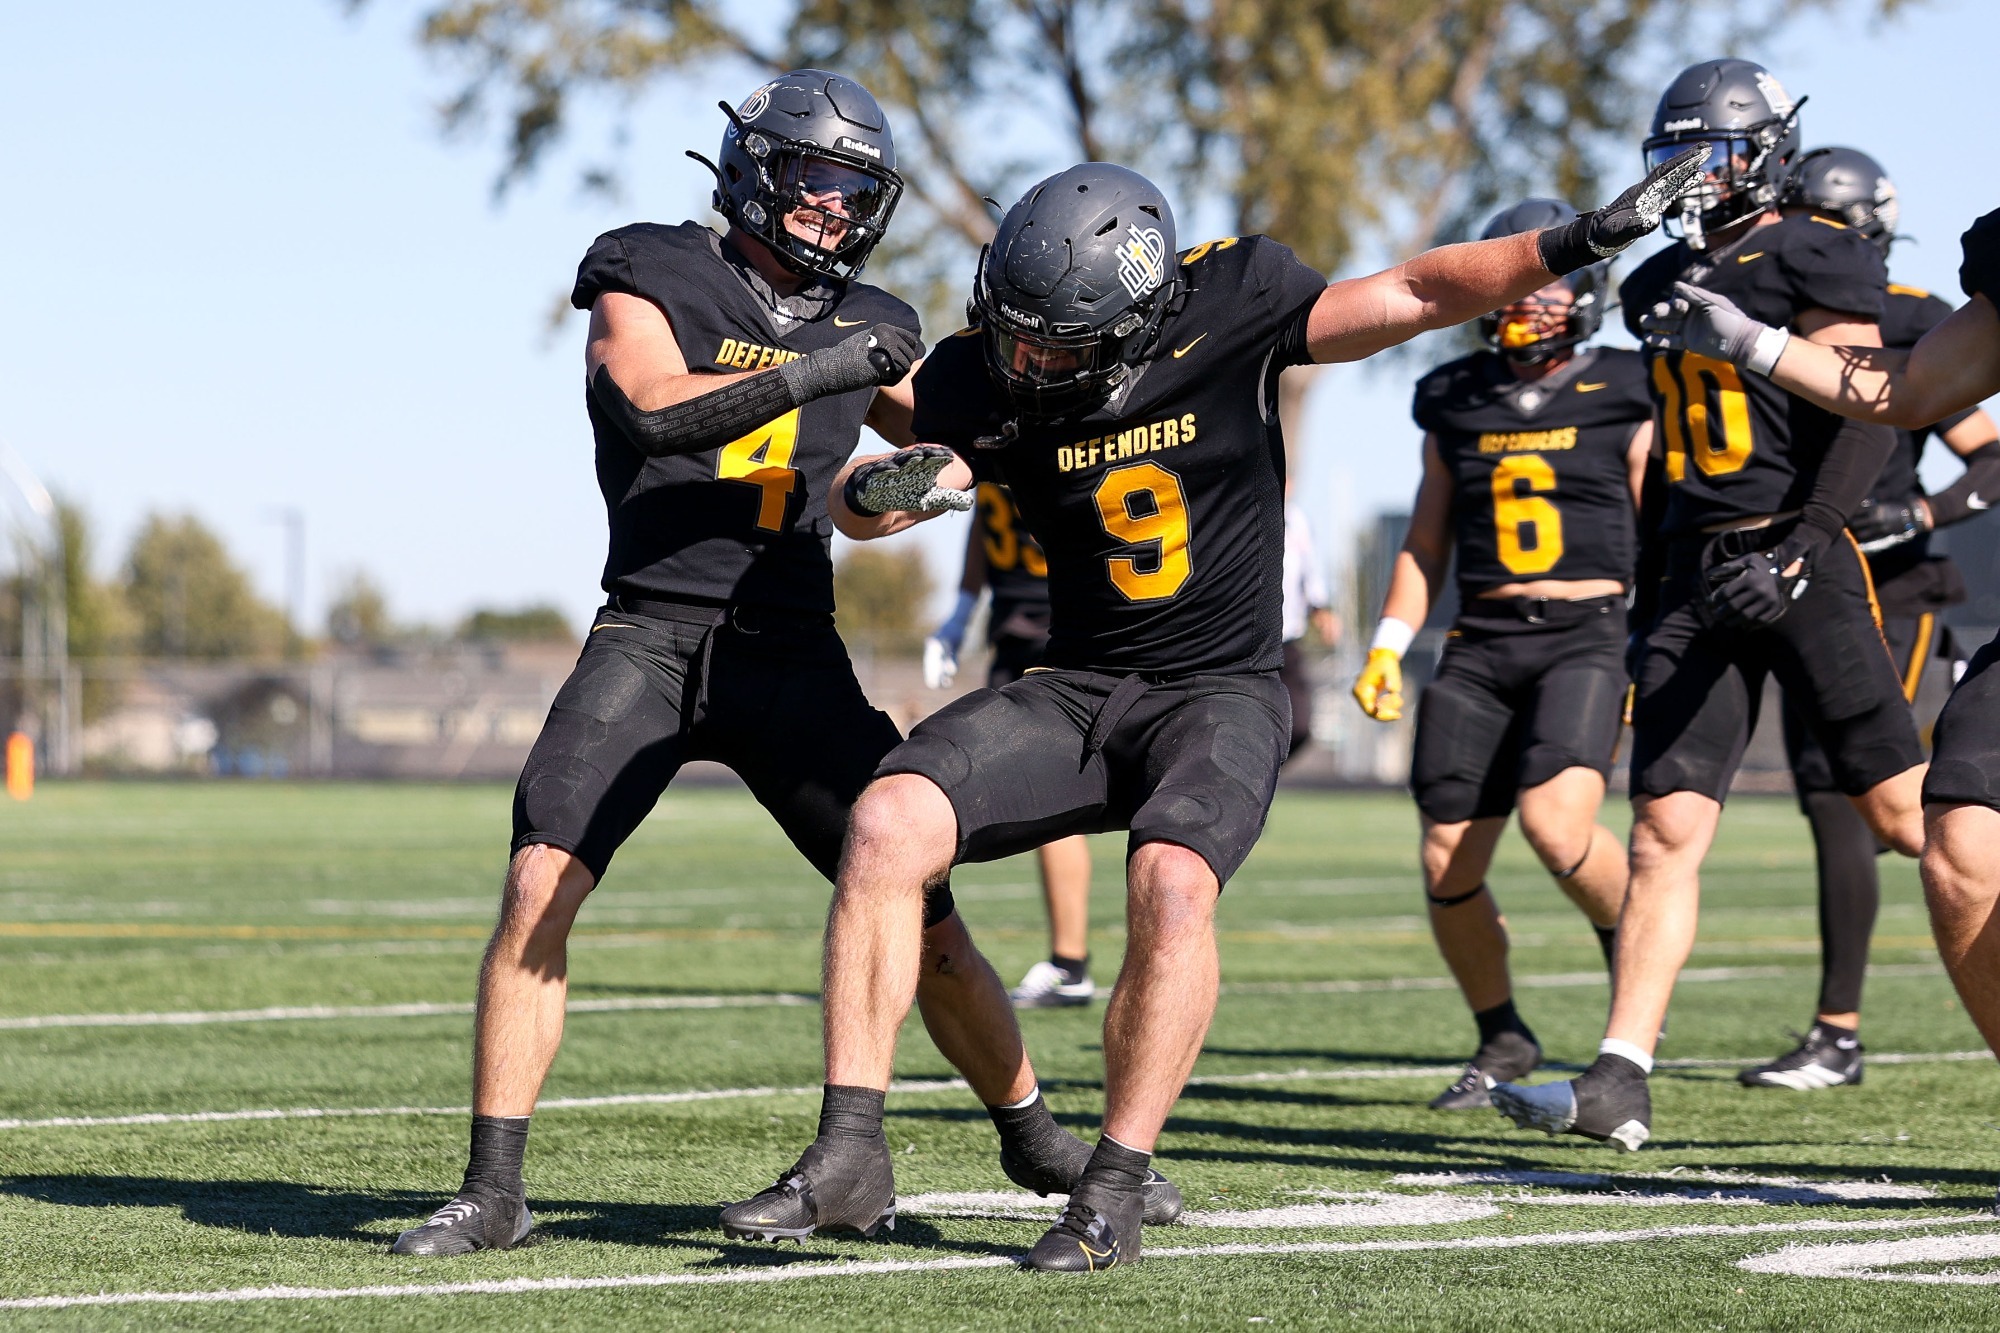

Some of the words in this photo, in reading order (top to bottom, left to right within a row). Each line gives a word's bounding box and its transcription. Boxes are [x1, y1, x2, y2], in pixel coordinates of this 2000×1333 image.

[842, 137, 881, 159] Riddell
[804, 249, 825, 262] Ridell
[715, 338, 807, 370] DEFEN
[1001, 303, 1040, 329] Riddell
[1057, 412, 1197, 473] DEFENDERS
[1652, 349, 1754, 483] 10
[714, 405, 801, 534] 4
[976, 481, 1048, 578] 3
[1092, 459, 1194, 603] 9
[1491, 453, 1564, 576] 6
